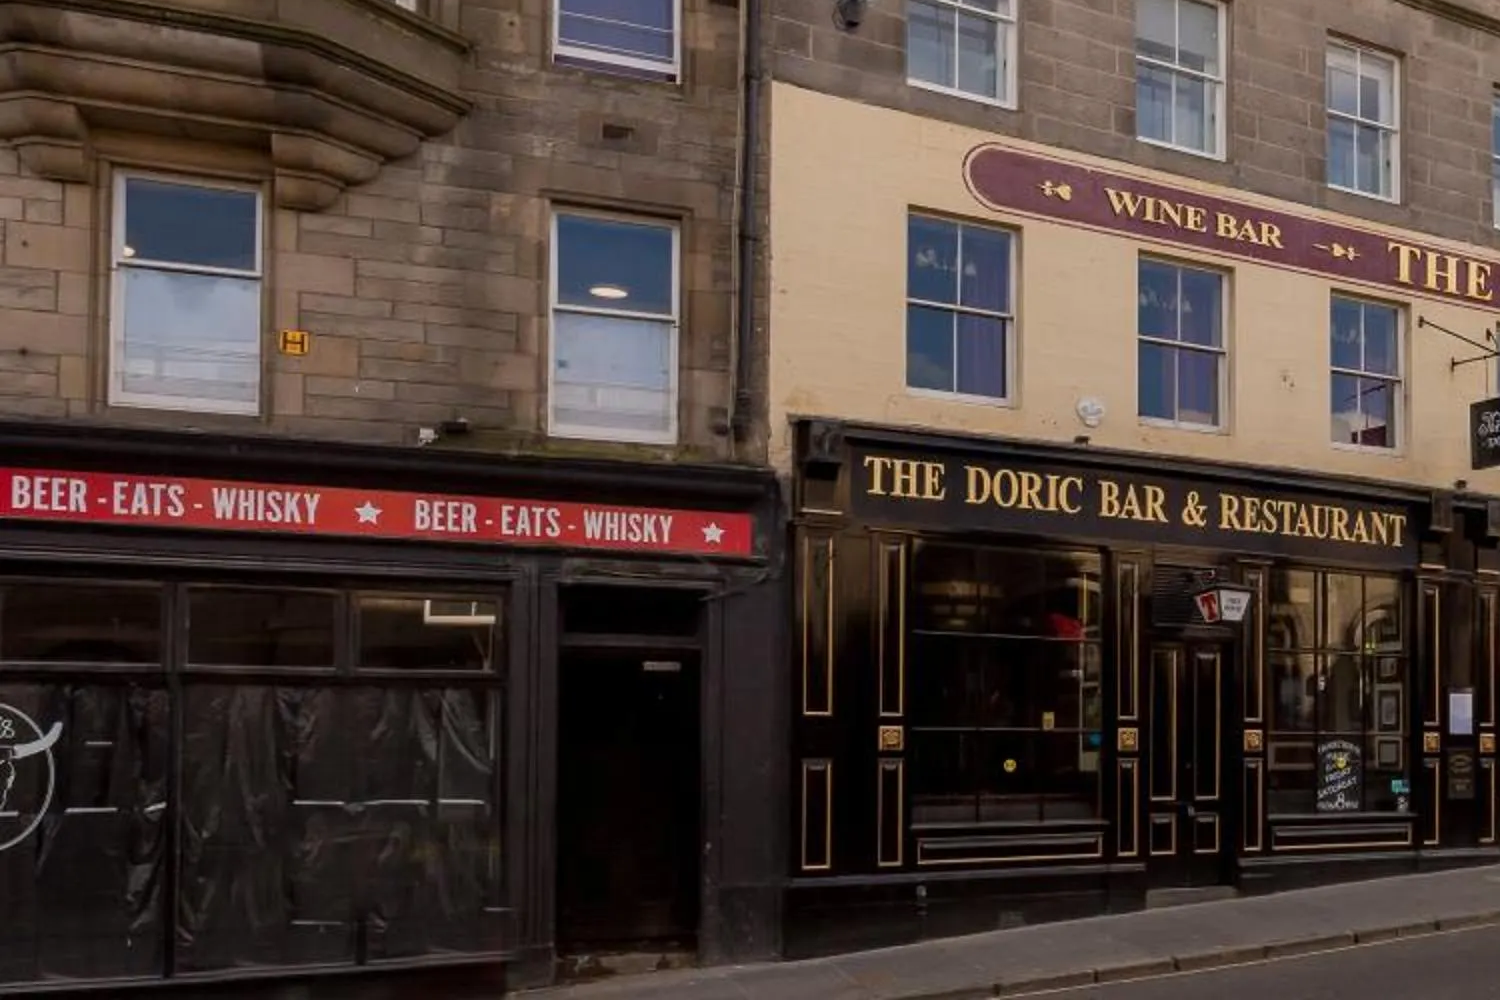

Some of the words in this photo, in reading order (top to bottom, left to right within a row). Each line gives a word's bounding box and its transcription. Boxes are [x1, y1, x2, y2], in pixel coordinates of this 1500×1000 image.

[1104, 187, 1207, 233] WINE
[1216, 210, 1284, 249] BAR
[1388, 242, 1494, 301] THE
[11, 476, 87, 513] BEER
[112, 481, 185, 518] EATS
[212, 487, 321, 525] WHISKY
[415, 500, 477, 533] BEER
[501, 505, 561, 538] EATS
[584, 510, 673, 545] WHISKY
[864, 456, 945, 500] THE
[965, 466, 1083, 514] DORIC
[1099, 481, 1168, 523] BAR
[1182, 491, 1207, 527] &
[1219, 494, 1407, 547] RESTAURANT
